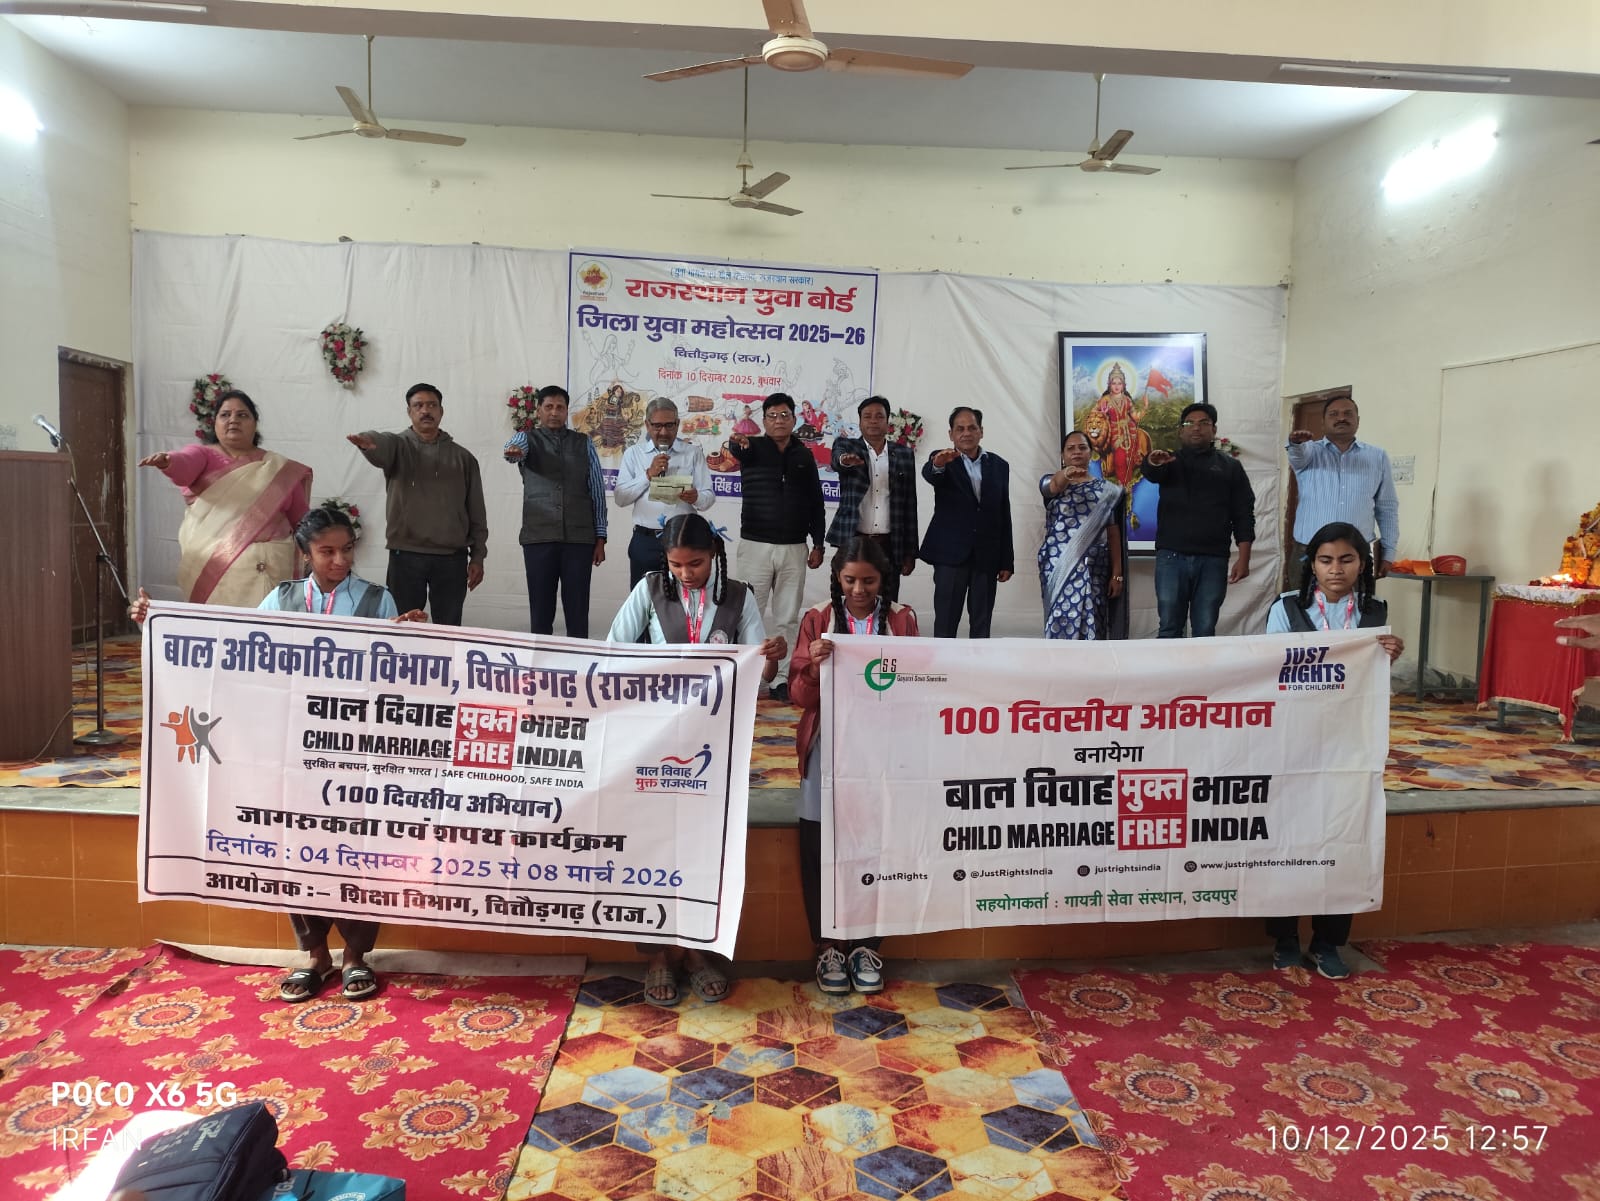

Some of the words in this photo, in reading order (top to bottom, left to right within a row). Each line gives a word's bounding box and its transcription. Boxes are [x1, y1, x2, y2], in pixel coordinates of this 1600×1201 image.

[625, 279, 748, 304] राजस्थान
[752, 288, 803, 315] युवा
[807, 286, 857, 313] बोर्ड
[577, 305, 639, 332] जिला
[643, 316, 688, 341] युवा
[691, 315, 784, 341] महोत्सव
[733, 351, 771, 366] (राज.)
[658, 368, 682, 380] दिनांक
[687, 372, 696, 381] 10
[699, 370, 727, 383] दिसम्बर
[730, 374, 755, 386] 2025,
[758, 375, 782, 388] बुधवार
[1283, 646, 1330, 665] JUST
[163, 633, 217, 669] बाल
[220, 631, 367, 682] अधिकारिता
[369, 641, 460, 695] विभाग,
[466, 650, 578, 707] चित्तौड़गढ़
[585, 661, 724, 716] (राजस्थान)
[1279, 663, 1346, 683] RIGHTS
[1305, 683, 1340, 691] CHILDREN
[306, 694, 369, 723] बाल
[459, 706, 516, 740] मुक्त
[520, 713, 590, 741] भारत
[939, 706, 999, 735] 100
[1008, 698, 1132, 734] दिवसीय
[1140, 695, 1276, 731] अभियान
[302, 729, 354, 752] CHILD
[358, 734, 453, 759] MARRIAGE
[457, 741, 509, 765] FREE
[516, 745, 584, 770] INDIA
[1074, 741, 1145, 763] बनायेगा
[303, 757, 336, 770] सुरक्षित
[338, 761, 370, 772] बचपन,
[372, 762, 405, 775] सुरक्षित
[407, 766, 433, 777] भारत
[636, 766, 659, 776] बाल
[661, 764, 692, 778] विवाह
[441, 769, 464, 779] SAFE
[467, 771, 527, 785] CHILDHOOD,
[529, 776, 553, 786] SAFE
[555, 778, 584, 789] INDIA
[635, 778, 658, 791] मुक्त
[660, 778, 708, 790] राजस्थान
[943, 777, 1016, 811] बाल
[1023, 767, 1115, 808] विवाह
[1120, 773, 1186, 813] मुक्त
[1192, 775, 1272, 805] भारत
[322, 779, 379, 806] (100
[383, 783, 463, 812] दिवसीय
[466, 792, 563, 824] अभियान)
[386, 817, 431, 841] एवं
[433, 824, 505, 847] शपथ
[509, 826, 627, 853] कार्यक्रम
[942, 825, 1002, 852] CHILD
[1008, 821, 1115, 849] MARRIAGE
[1122, 818, 1182, 847] FREE
[1191, 816, 1269, 843] INDIA
[206, 829, 277, 860] दिनांक
[300, 845, 330, 865] 04
[336, 843, 423, 873] दिसम्बर
[430, 857, 492, 878] 2025
[498, 857, 520, 880] से
[527, 863, 558, 882] 08
[565, 860, 615, 885] मार्च
[621, 866, 683, 888] 2026
[1094, 863, 1161, 874] justrightsindia
[1200, 858, 1336, 871] www.justrightsforchildren.org
[876, 871, 928, 882] JustRights
[970, 867, 1053, 879] @JustRightsIndia
[205, 872, 302, 897] आयोजक
[340, 883, 400, 907] शिक्षा
[402, 888, 479, 917] विभाग,
[485, 894, 586, 924] चित्तौड़गढ़
[591, 900, 667, 929] (राज.)
[976, 892, 1049, 913] सहयोगकर्ता
[1064, 889, 1103, 908] गायत्री
[1107, 889, 1133, 906] सेवा
[1138, 888, 1187, 906] संस्थान,
[1192, 889, 1238, 906] उदयपुर
